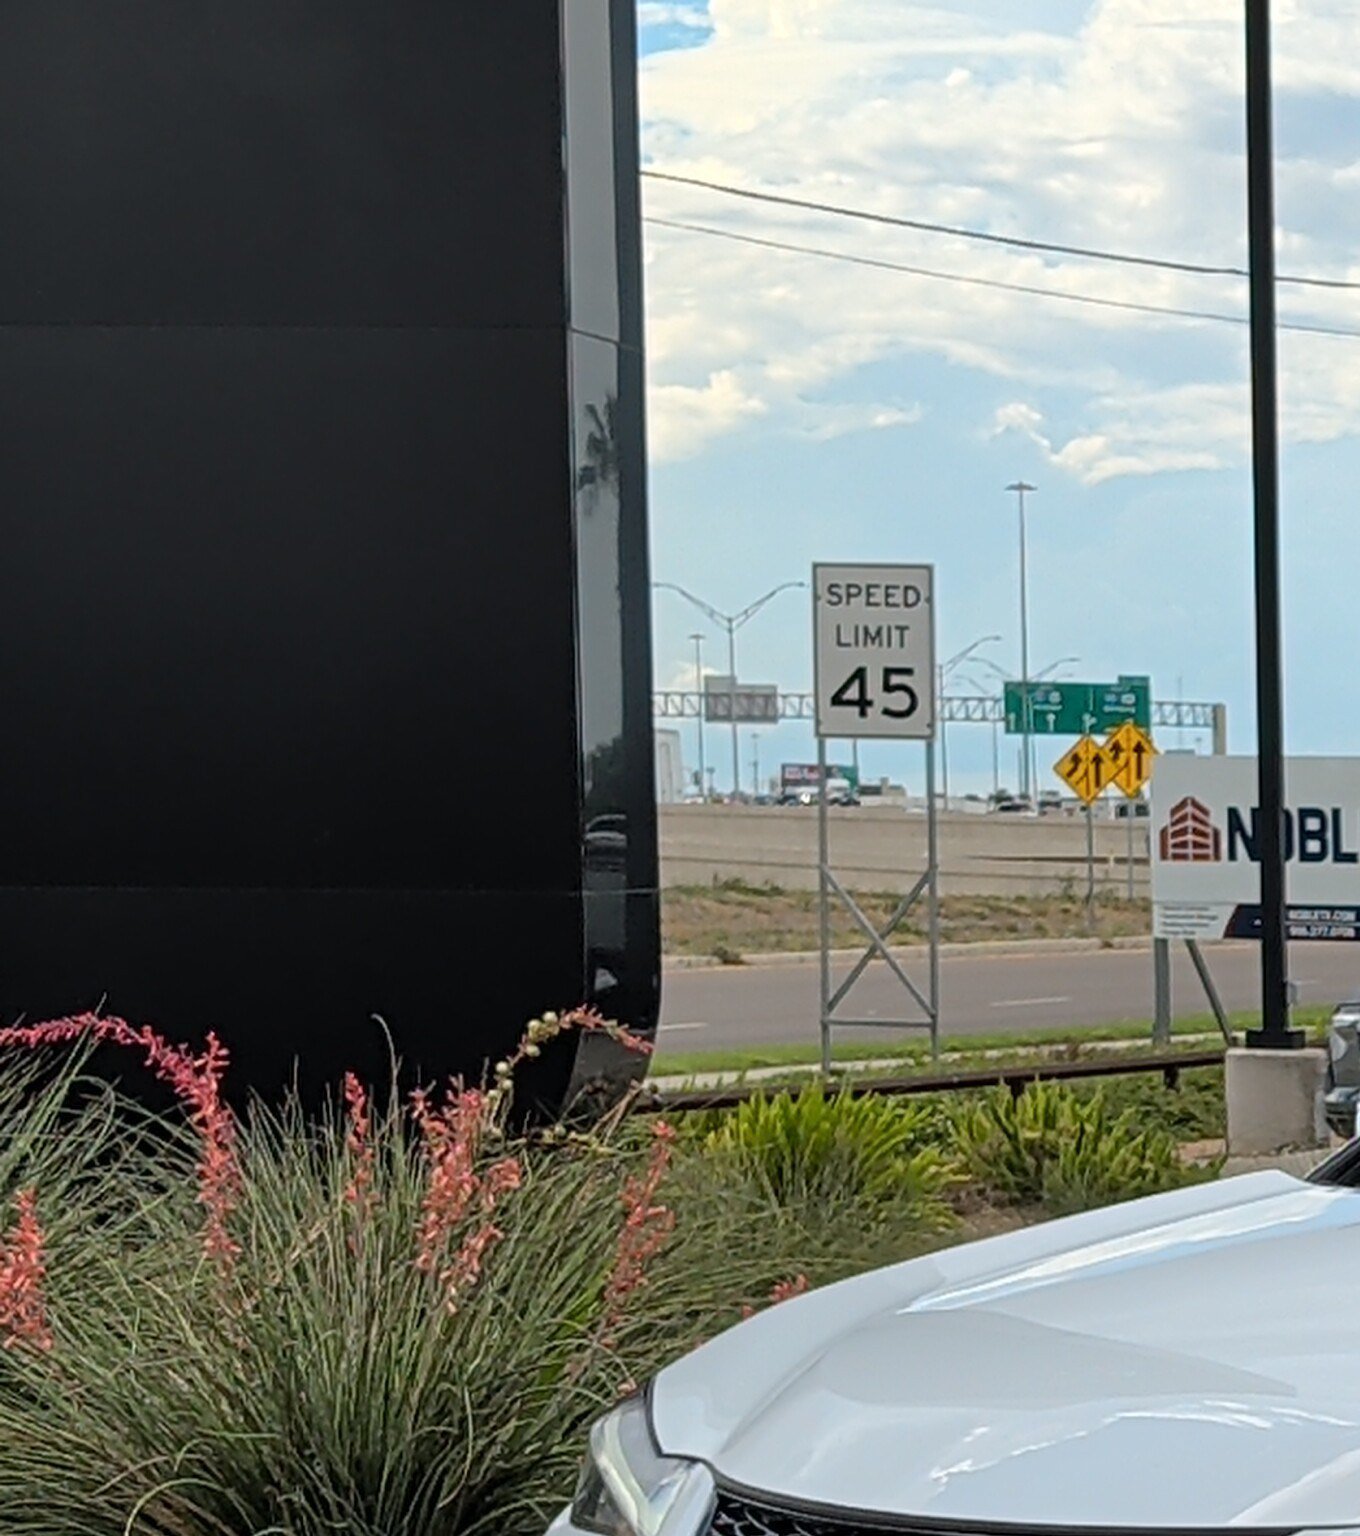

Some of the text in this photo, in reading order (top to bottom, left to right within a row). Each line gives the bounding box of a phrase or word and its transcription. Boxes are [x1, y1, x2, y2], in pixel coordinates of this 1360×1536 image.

[826, 583, 921, 608] SPEED
[836, 624, 910, 648] LIMIT
[830, 665, 919, 719] 45
